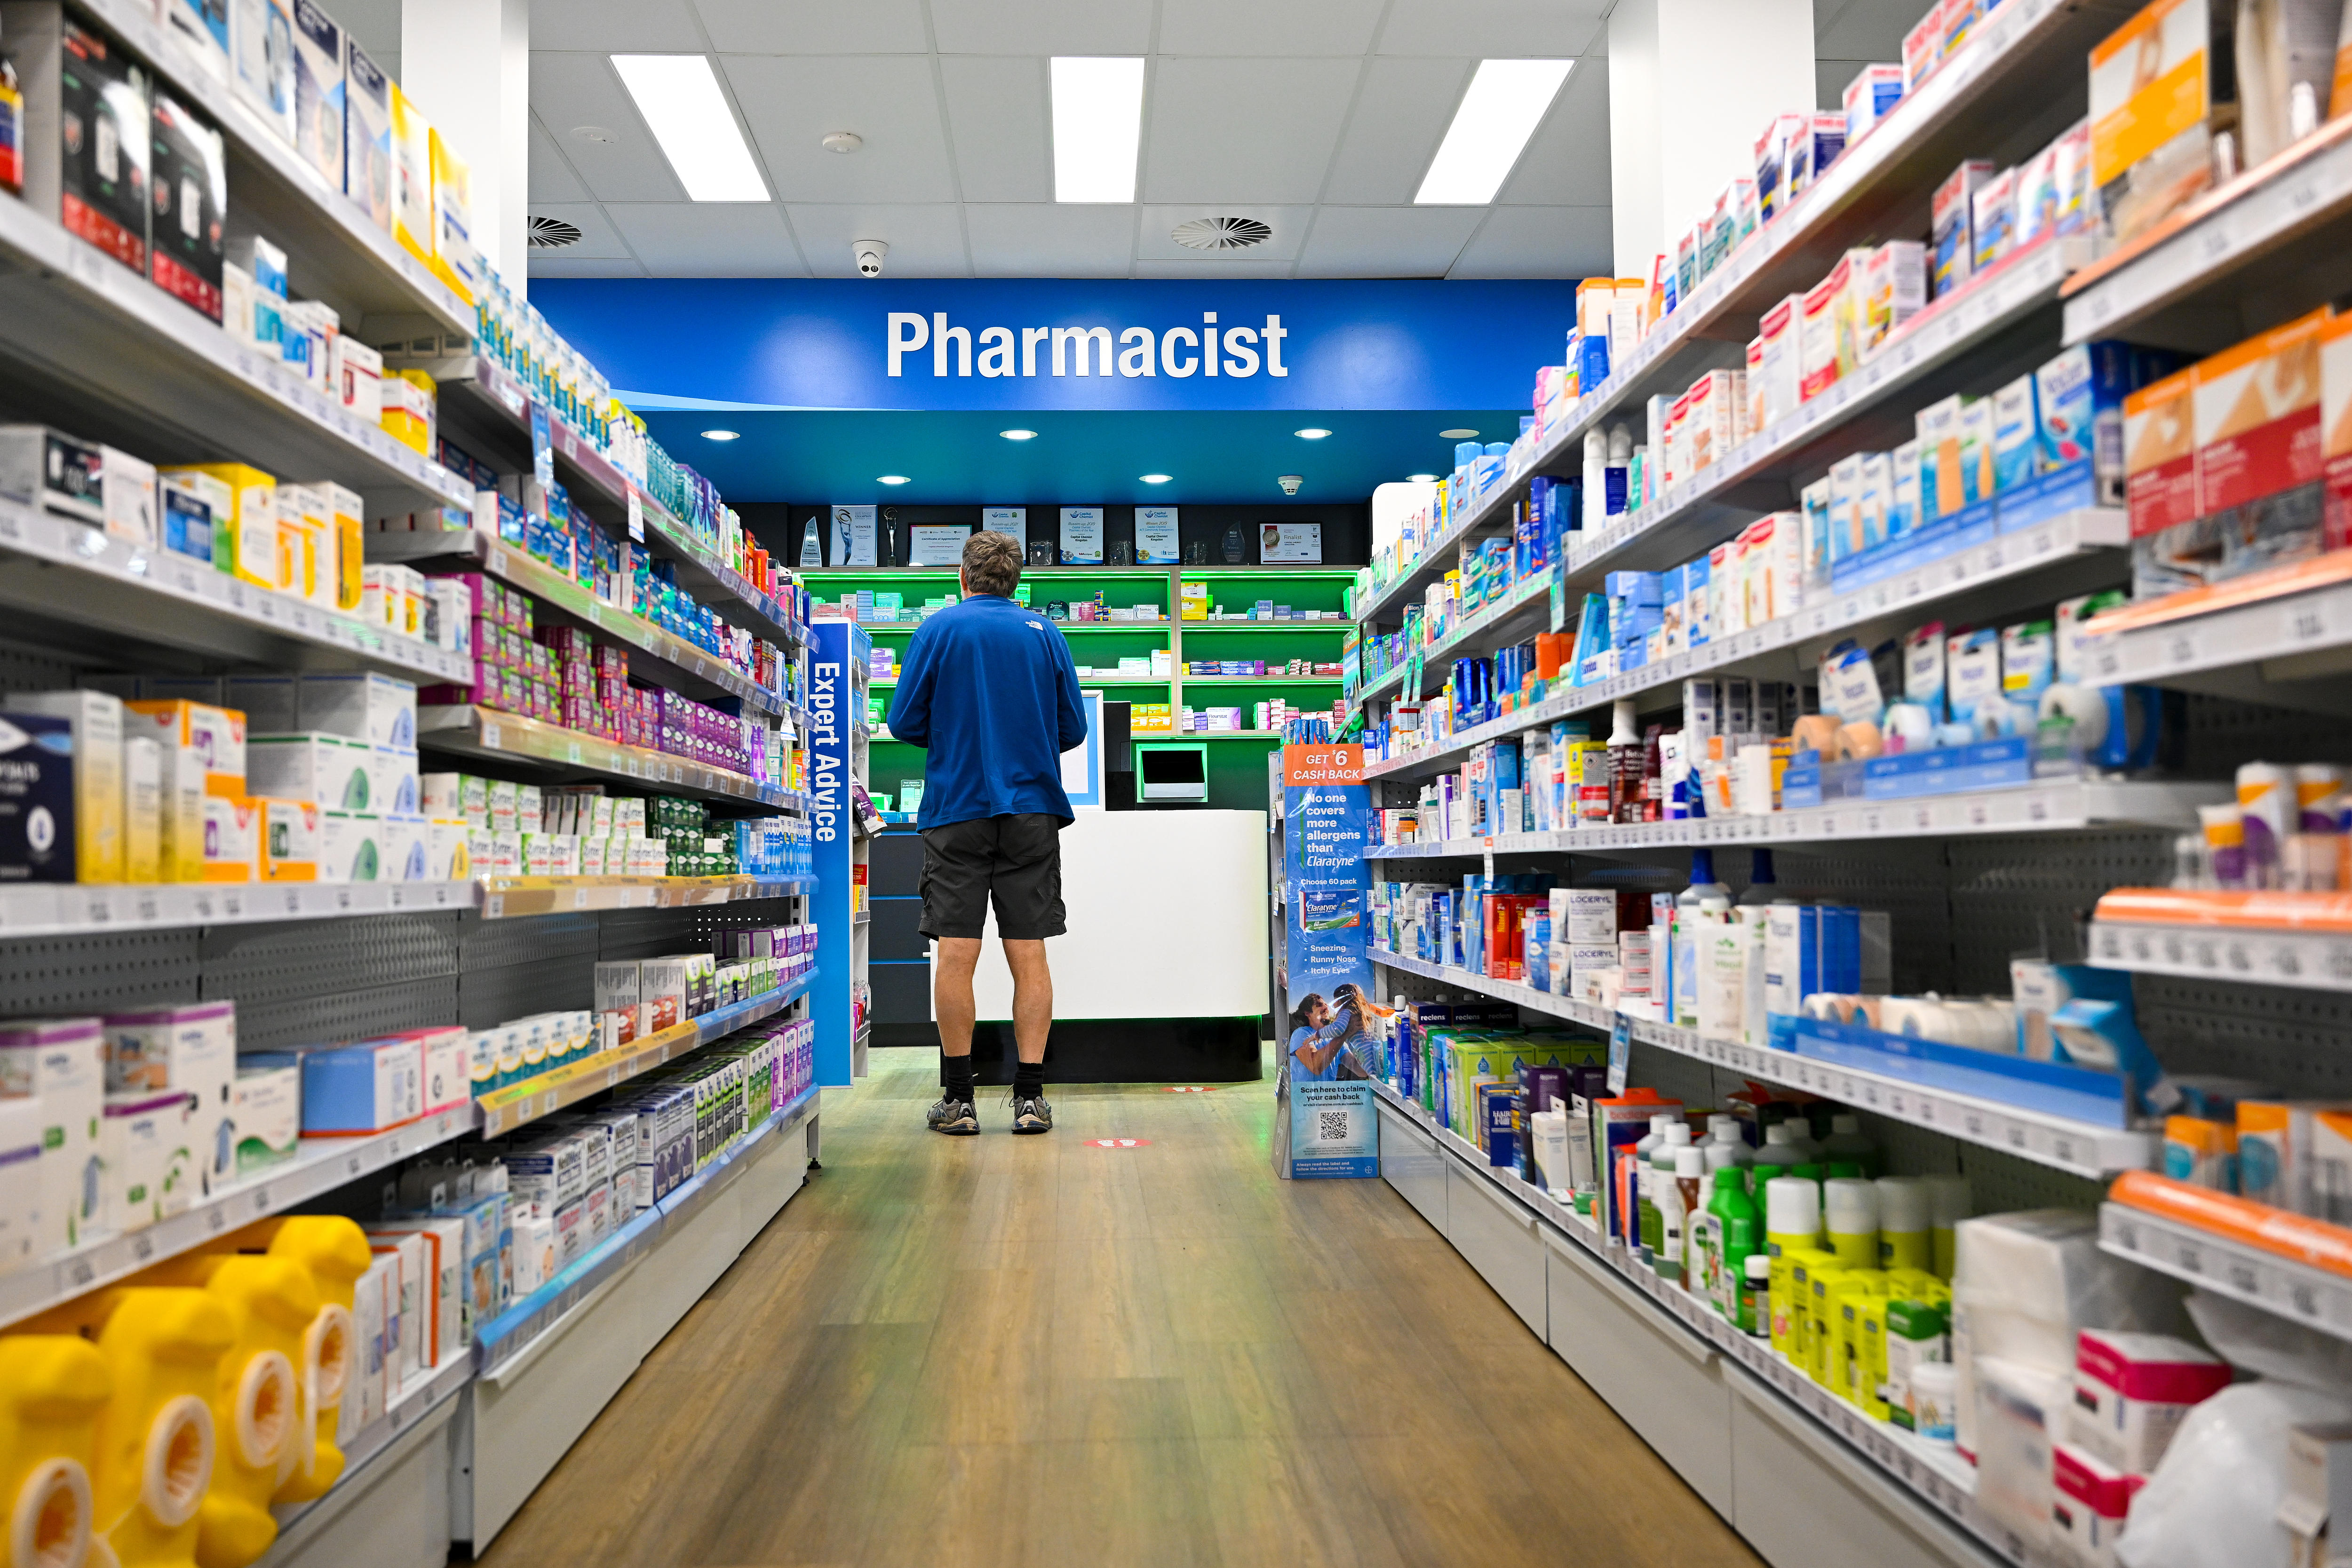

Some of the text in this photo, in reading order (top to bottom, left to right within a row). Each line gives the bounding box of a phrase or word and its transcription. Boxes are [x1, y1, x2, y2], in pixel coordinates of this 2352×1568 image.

[887, 312, 1288, 378] Pharmacist
[809, 662, 841, 842] Expert Advice
[1306, 755, 1329, 764] GET
[1294, 769, 1361, 780] CASH BACK
[1307, 793, 1323, 803] No
[1306, 807, 1345, 816] covers
[1307, 830, 1360, 842] allergens
[1307, 843, 1334, 852] than
[1307, 856, 1354, 868] Claratyne
[1570, 895, 1612, 904] LOCERYL
[1311, 944, 1346, 953] Sneezing
[1573, 949, 1614, 958] LOCERYL
